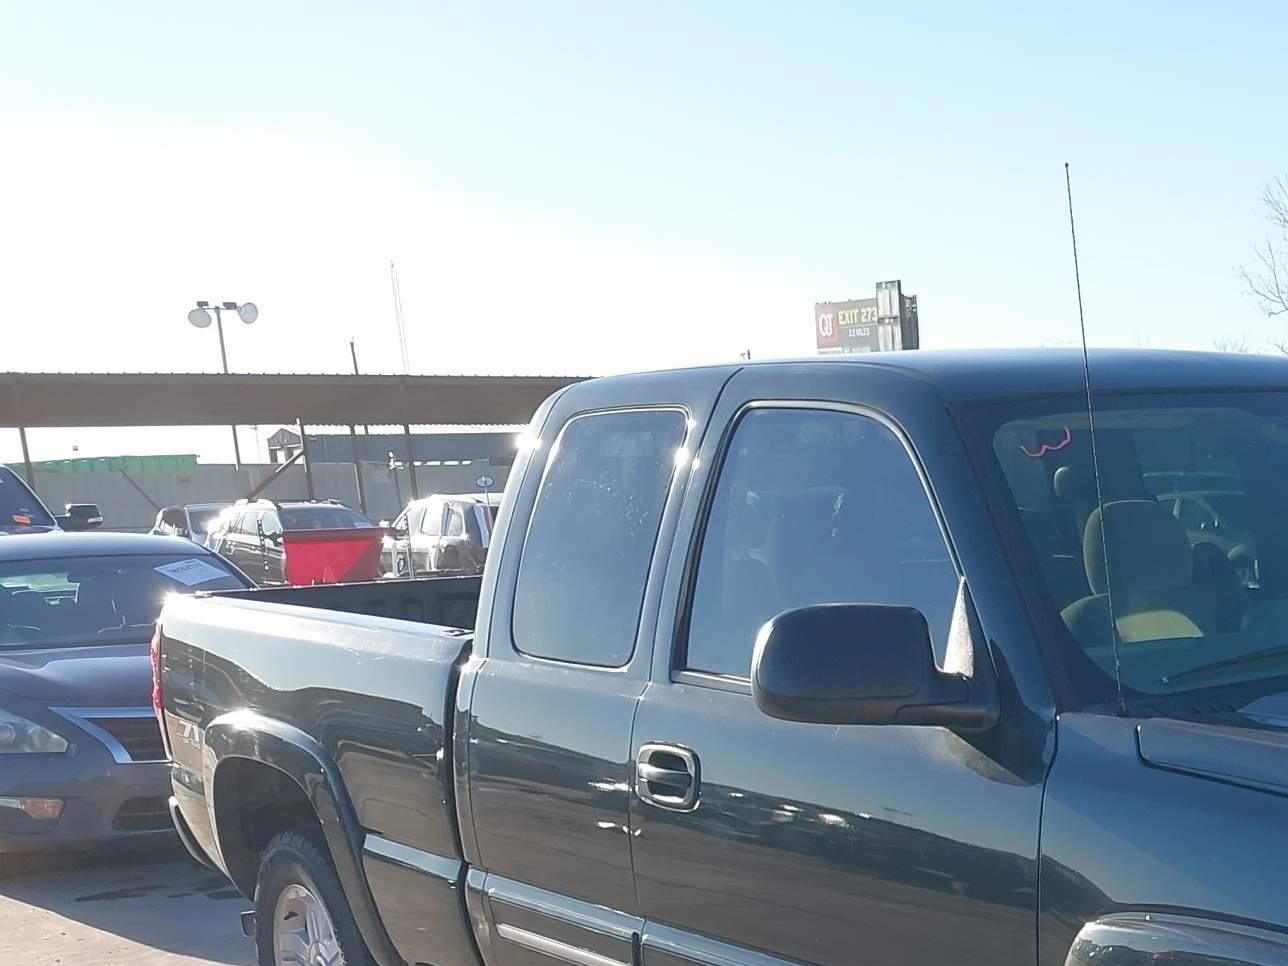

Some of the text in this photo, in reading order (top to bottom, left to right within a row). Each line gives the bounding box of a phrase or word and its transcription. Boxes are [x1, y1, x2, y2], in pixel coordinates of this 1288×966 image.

[819, 313, 833, 336] QT
[838, 306, 877, 325] EXIT 273
